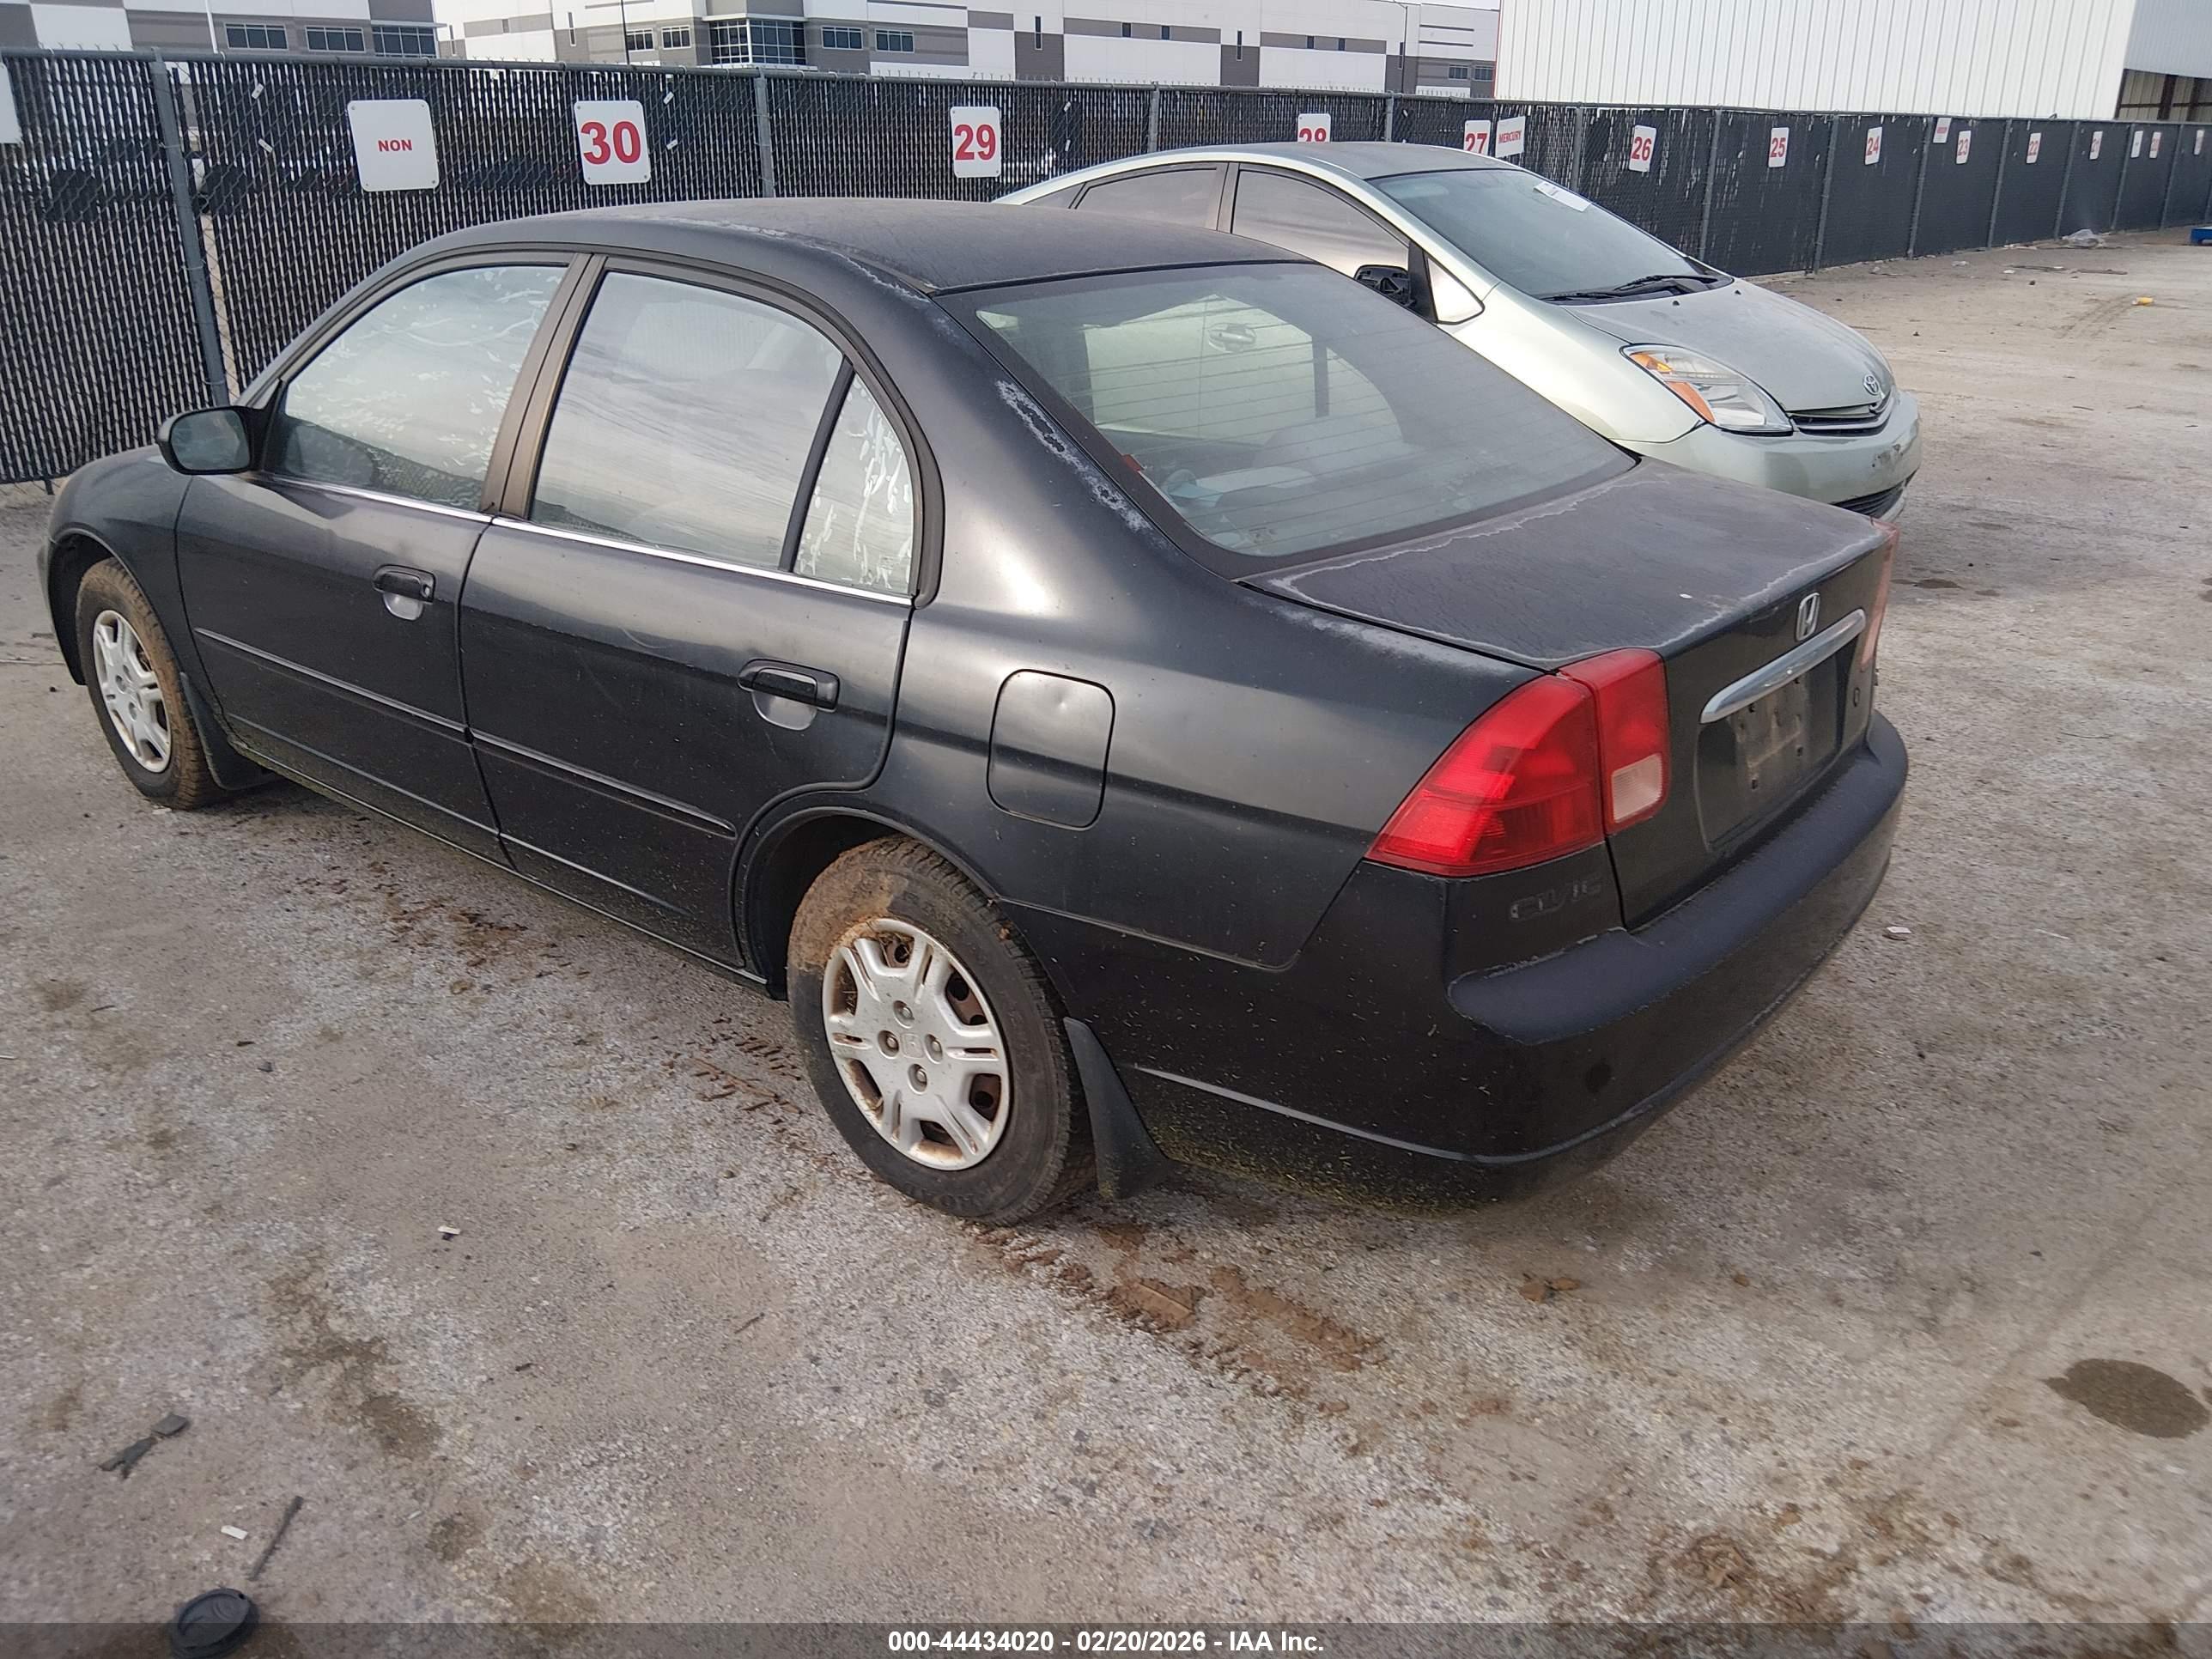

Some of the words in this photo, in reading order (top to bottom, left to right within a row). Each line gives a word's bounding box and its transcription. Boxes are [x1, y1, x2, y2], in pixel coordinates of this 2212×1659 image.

[378, 139, 413, 152] NON
[580, 120, 641, 165] 30
[954, 124, 996, 161] 29
[1465, 132, 1488, 154] 27
[1632, 137, 1652, 161] 26
[1771, 137, 1786, 157] 25
[1867, 136, 1880, 155] 24
[1958, 138, 1969, 155] 23
[2028, 140, 2039, 155] 22
